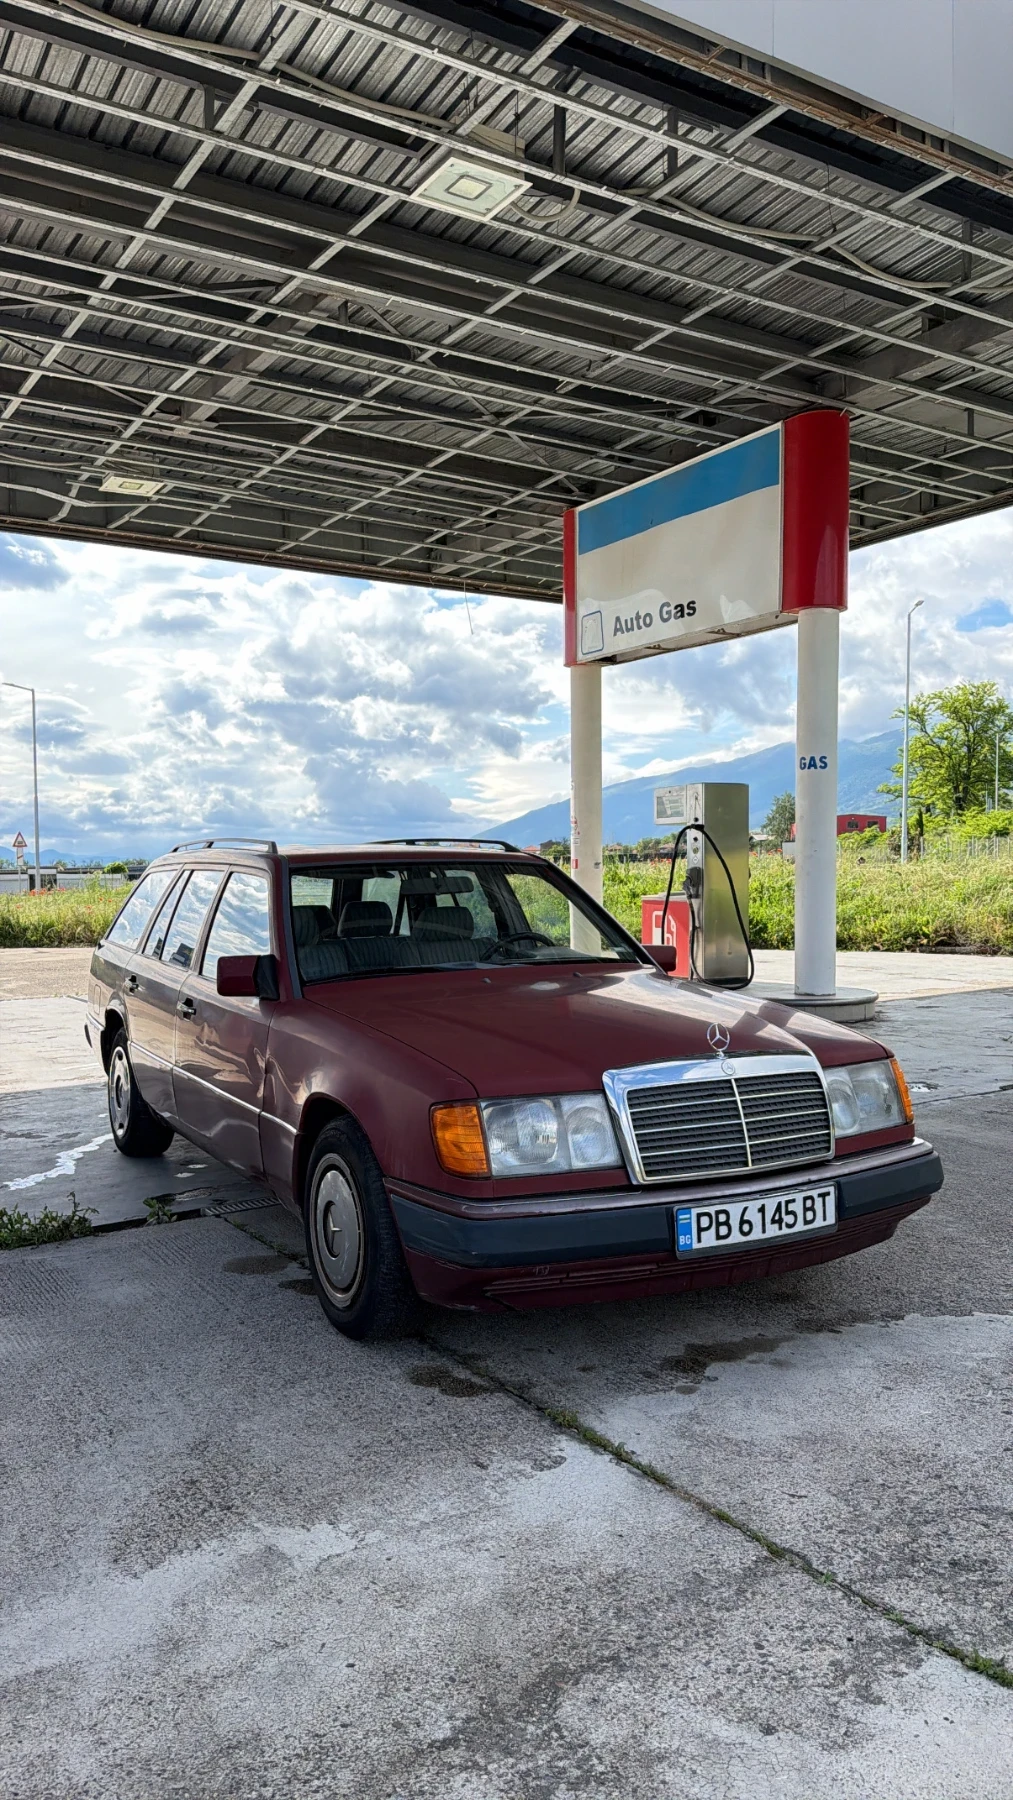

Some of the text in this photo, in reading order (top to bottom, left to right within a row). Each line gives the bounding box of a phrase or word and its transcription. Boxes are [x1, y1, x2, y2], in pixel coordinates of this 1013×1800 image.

[612, 599, 697, 637] Auto Gas
[799, 755, 828, 770] GAS
[679, 1235, 691, 1245] BG
